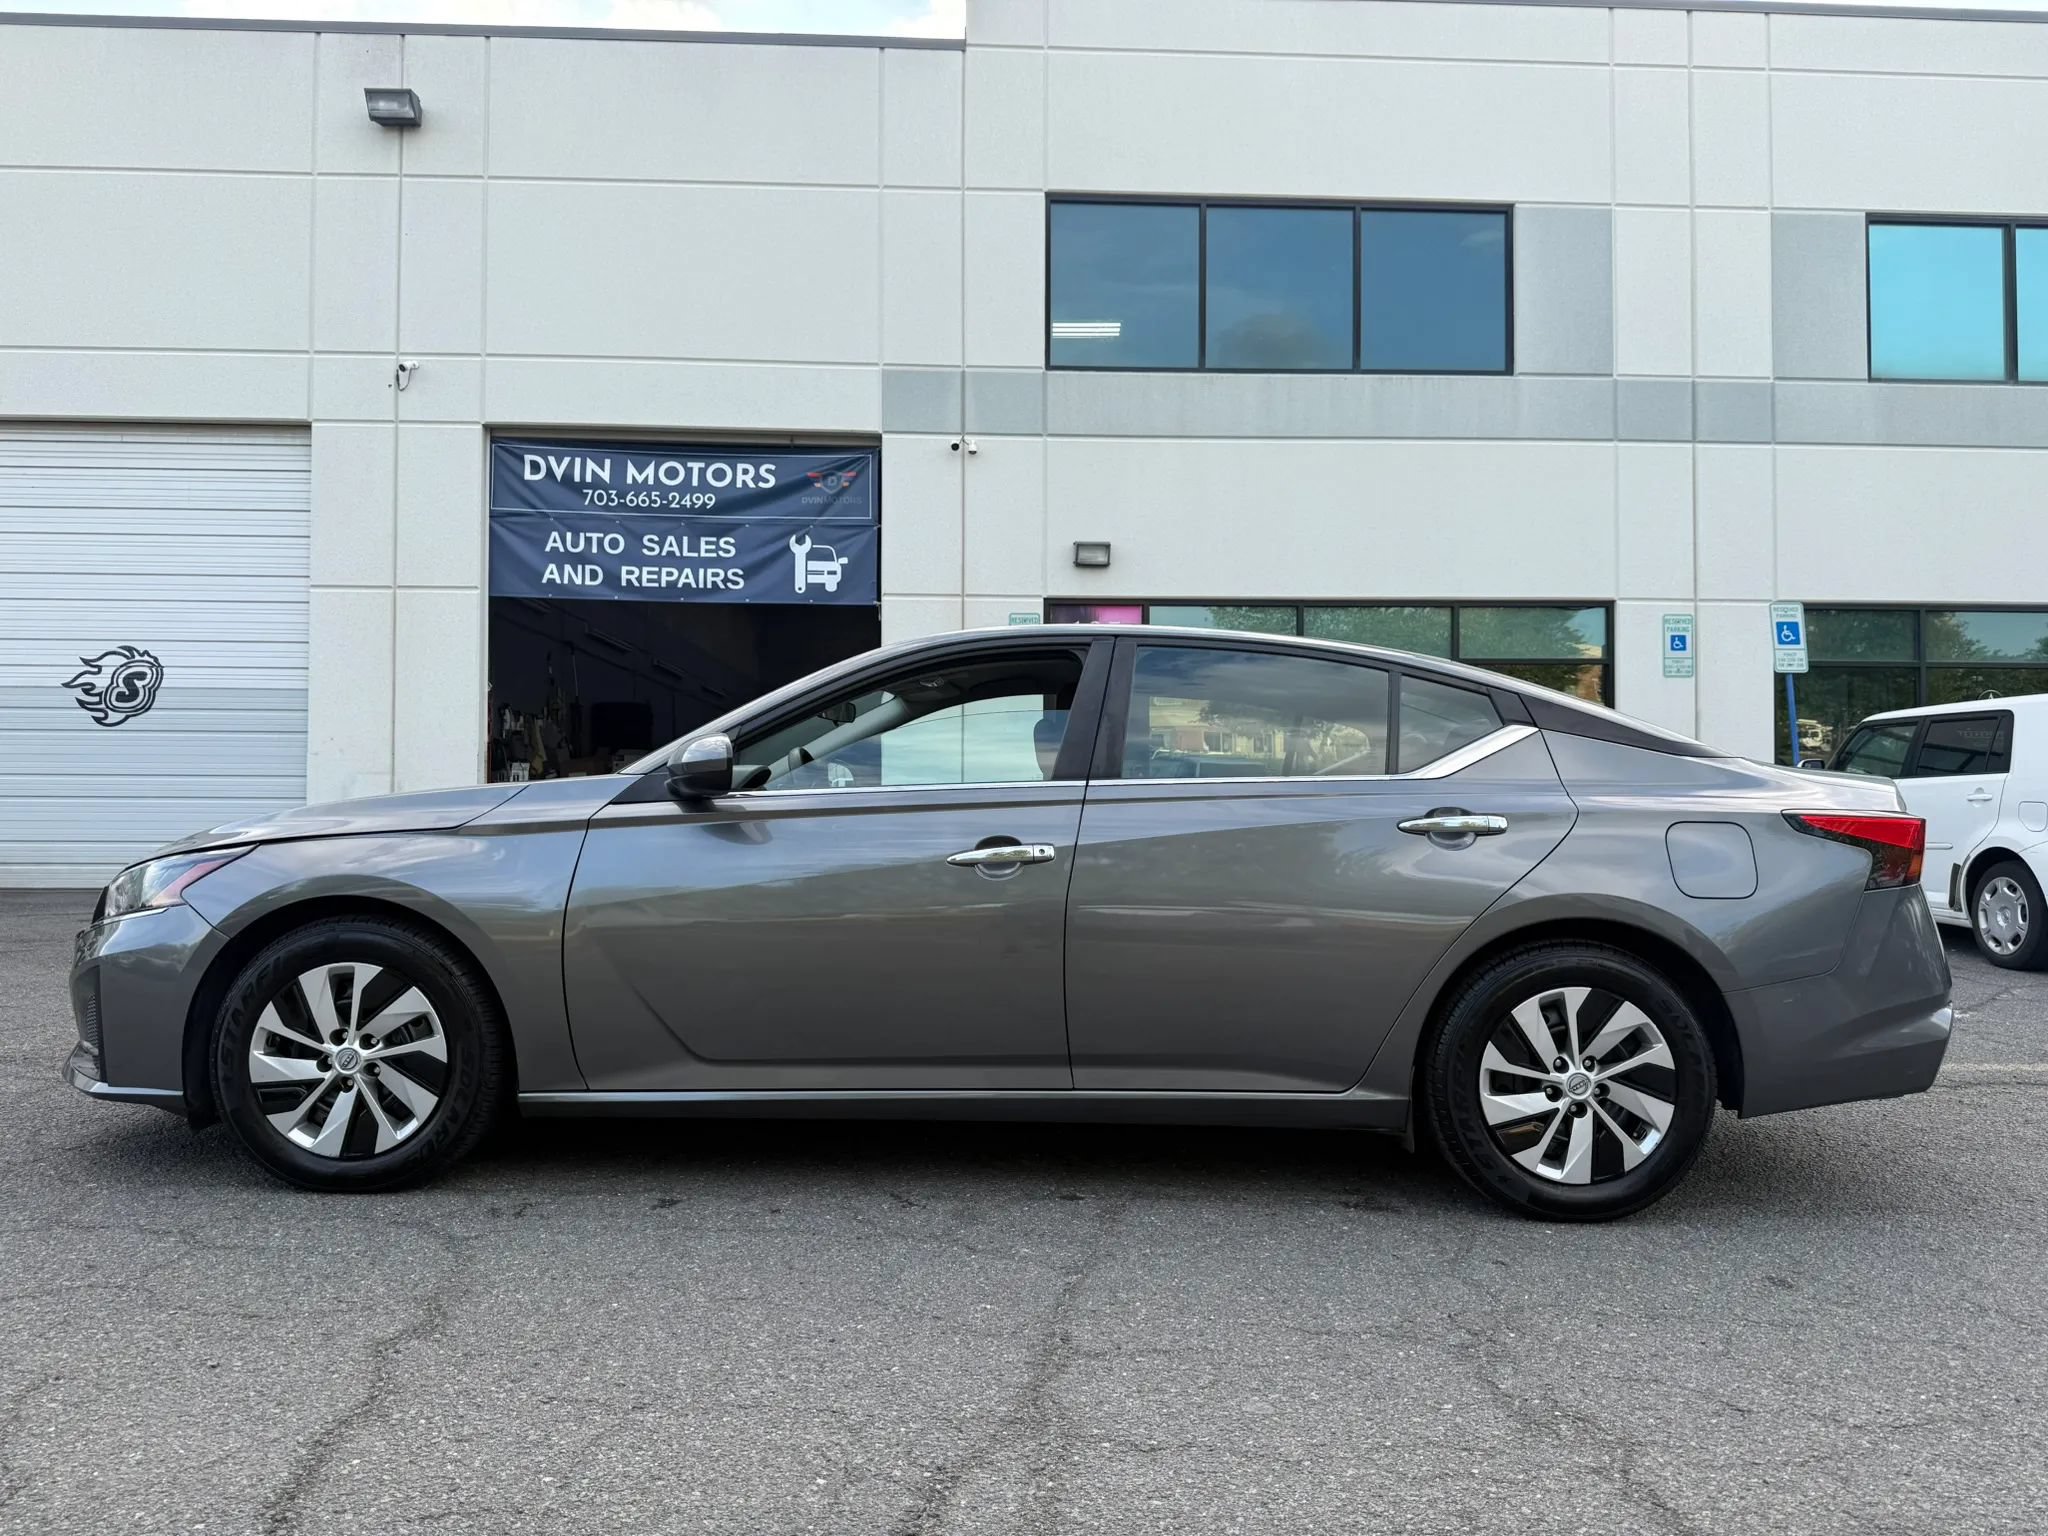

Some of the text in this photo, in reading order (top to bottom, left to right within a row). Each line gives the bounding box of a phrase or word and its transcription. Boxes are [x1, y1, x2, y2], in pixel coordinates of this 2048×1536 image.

[523, 454, 777, 489] DVIN MOTORS
[582, 489, 716, 509] 703-665-2499
[544, 531, 737, 558] AUTO SALES
[541, 562, 745, 590] AND REPAIRS
